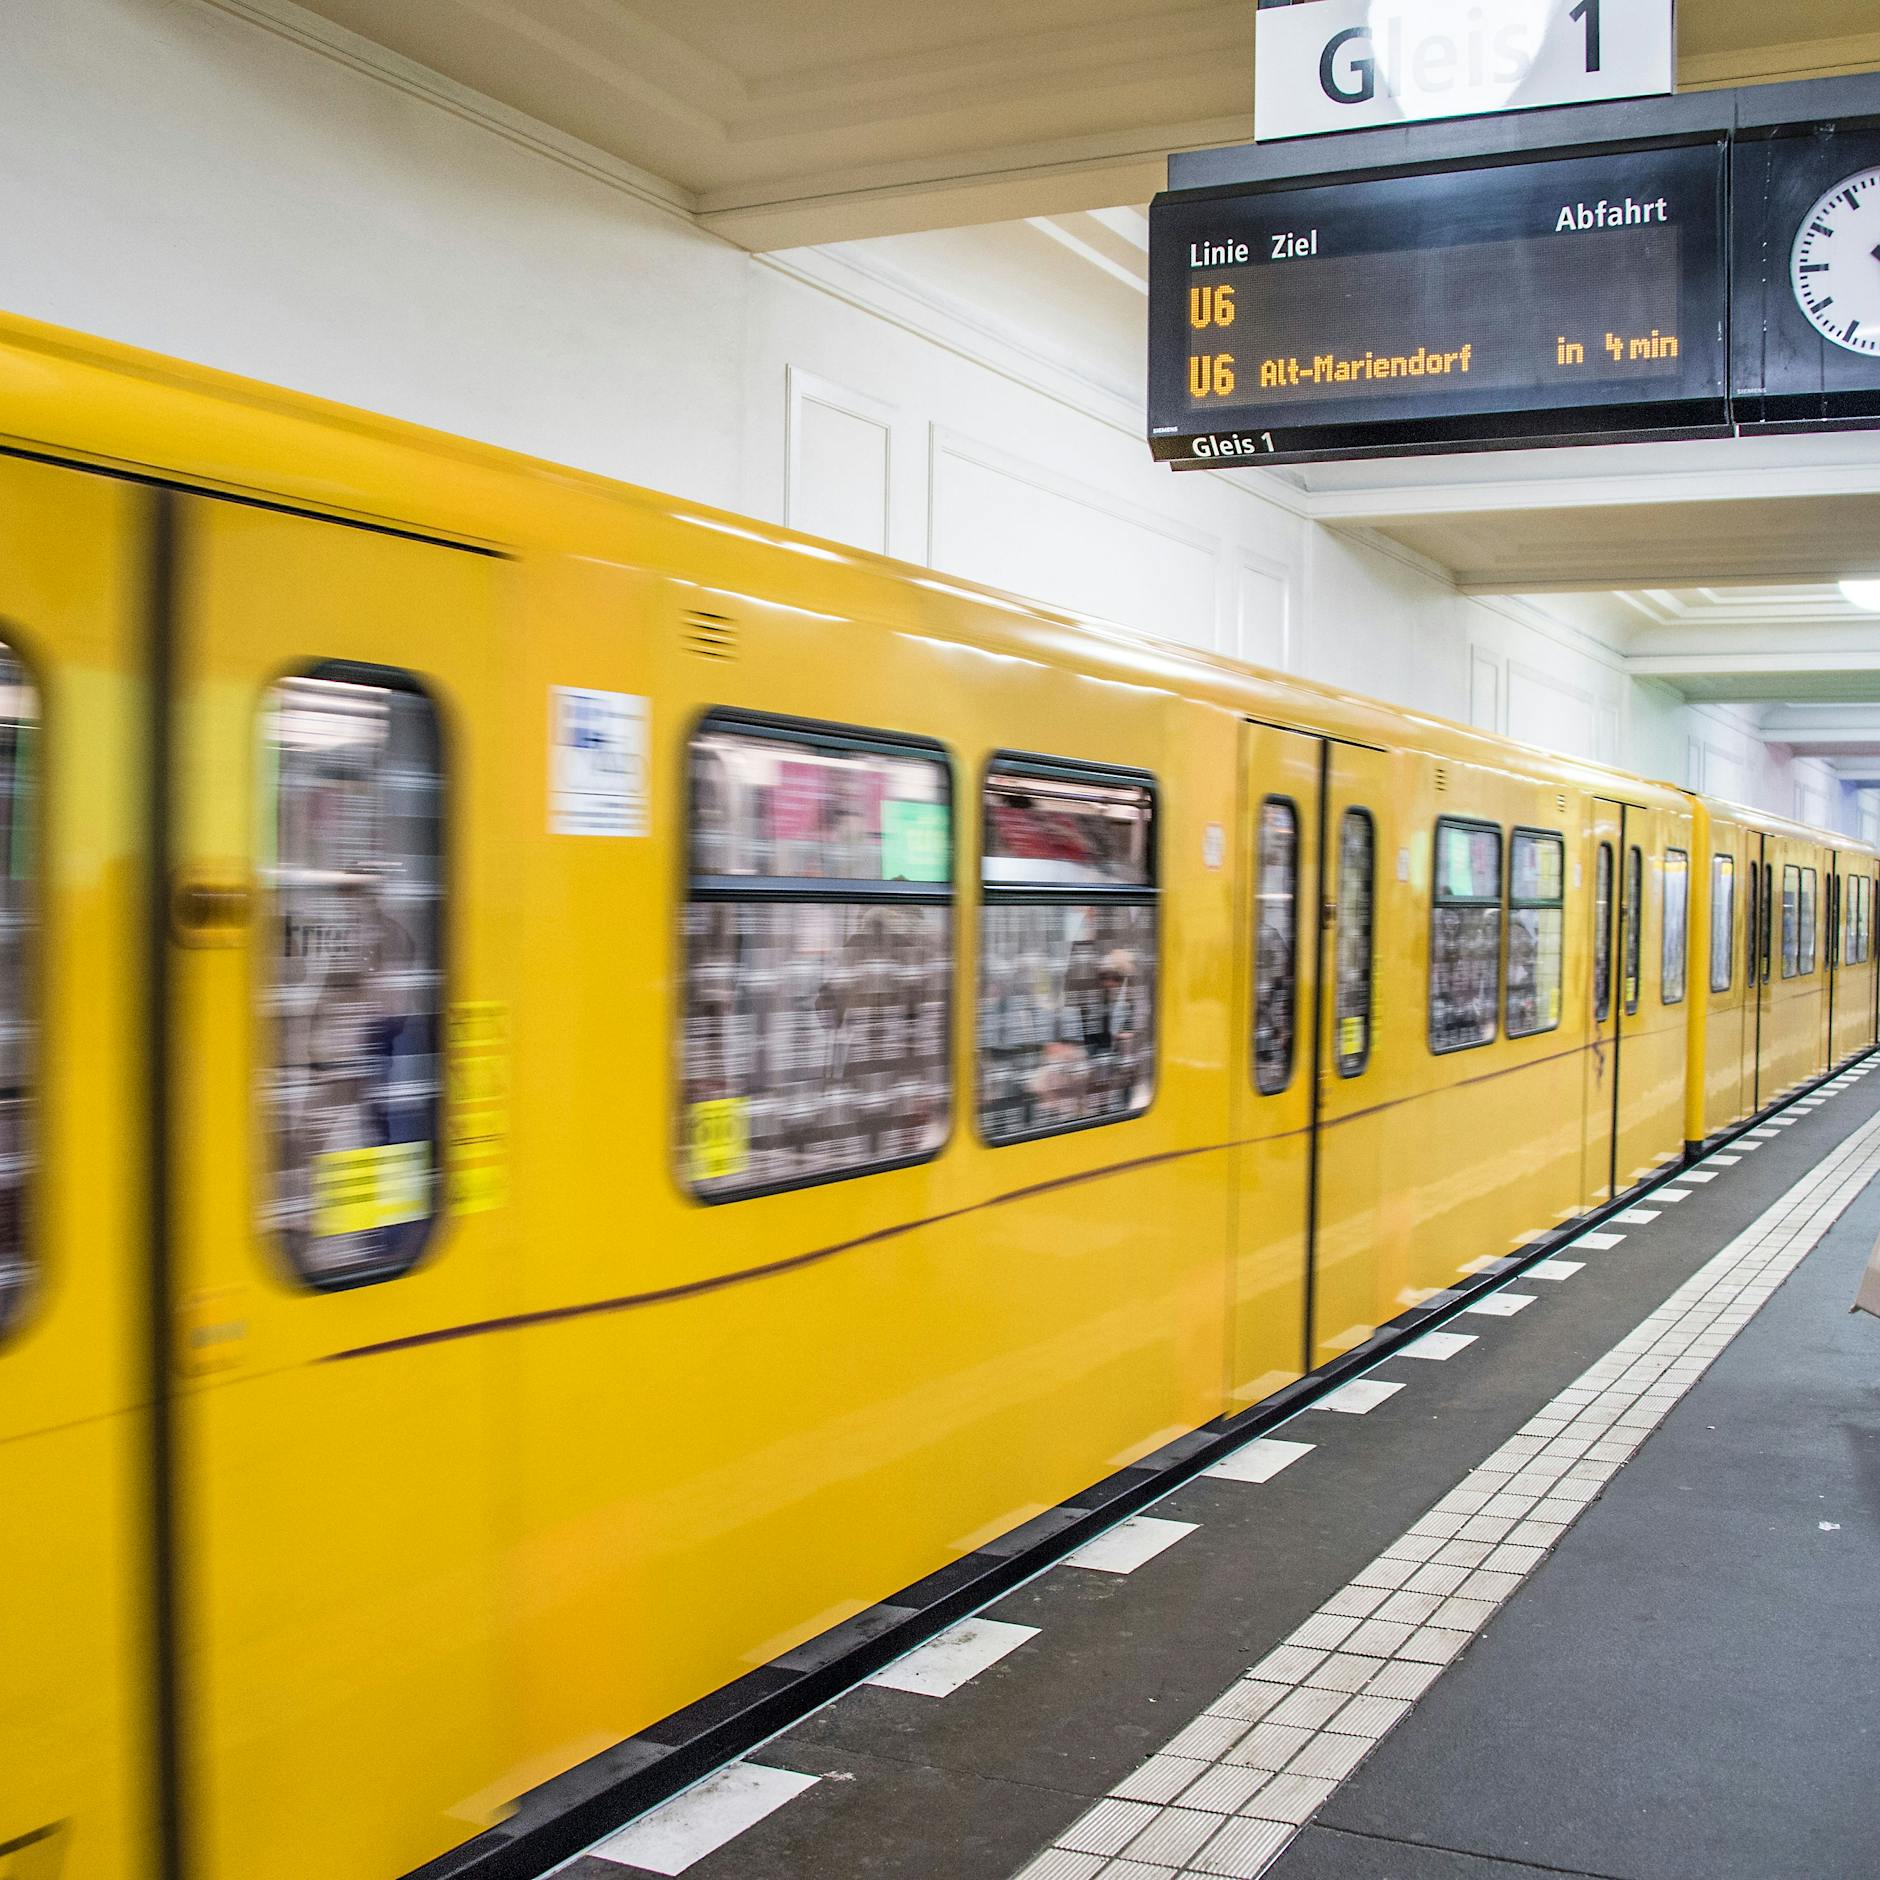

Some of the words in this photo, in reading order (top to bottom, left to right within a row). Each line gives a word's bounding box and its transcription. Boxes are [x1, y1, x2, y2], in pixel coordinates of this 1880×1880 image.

[1319, 7, 1530, 104] Gleis
[1569, 0, 1600, 73] 1
[1190, 239, 1249, 267] Linie
[1271, 229, 1318, 259] Ziel
[1555, 198, 1668, 232] Abfahrt
[1190, 284, 1236, 329] U6
[1190, 354, 1235, 398] U6
[1261, 344, 1472, 387] Alt-Mariendorf
[1557, 336, 1584, 365] in
[1606, 333, 1624, 361] 4
[1630, 329, 1679, 360] min
[1192, 434, 1255, 457] Gleis
[1261, 432, 1274, 452] 1
